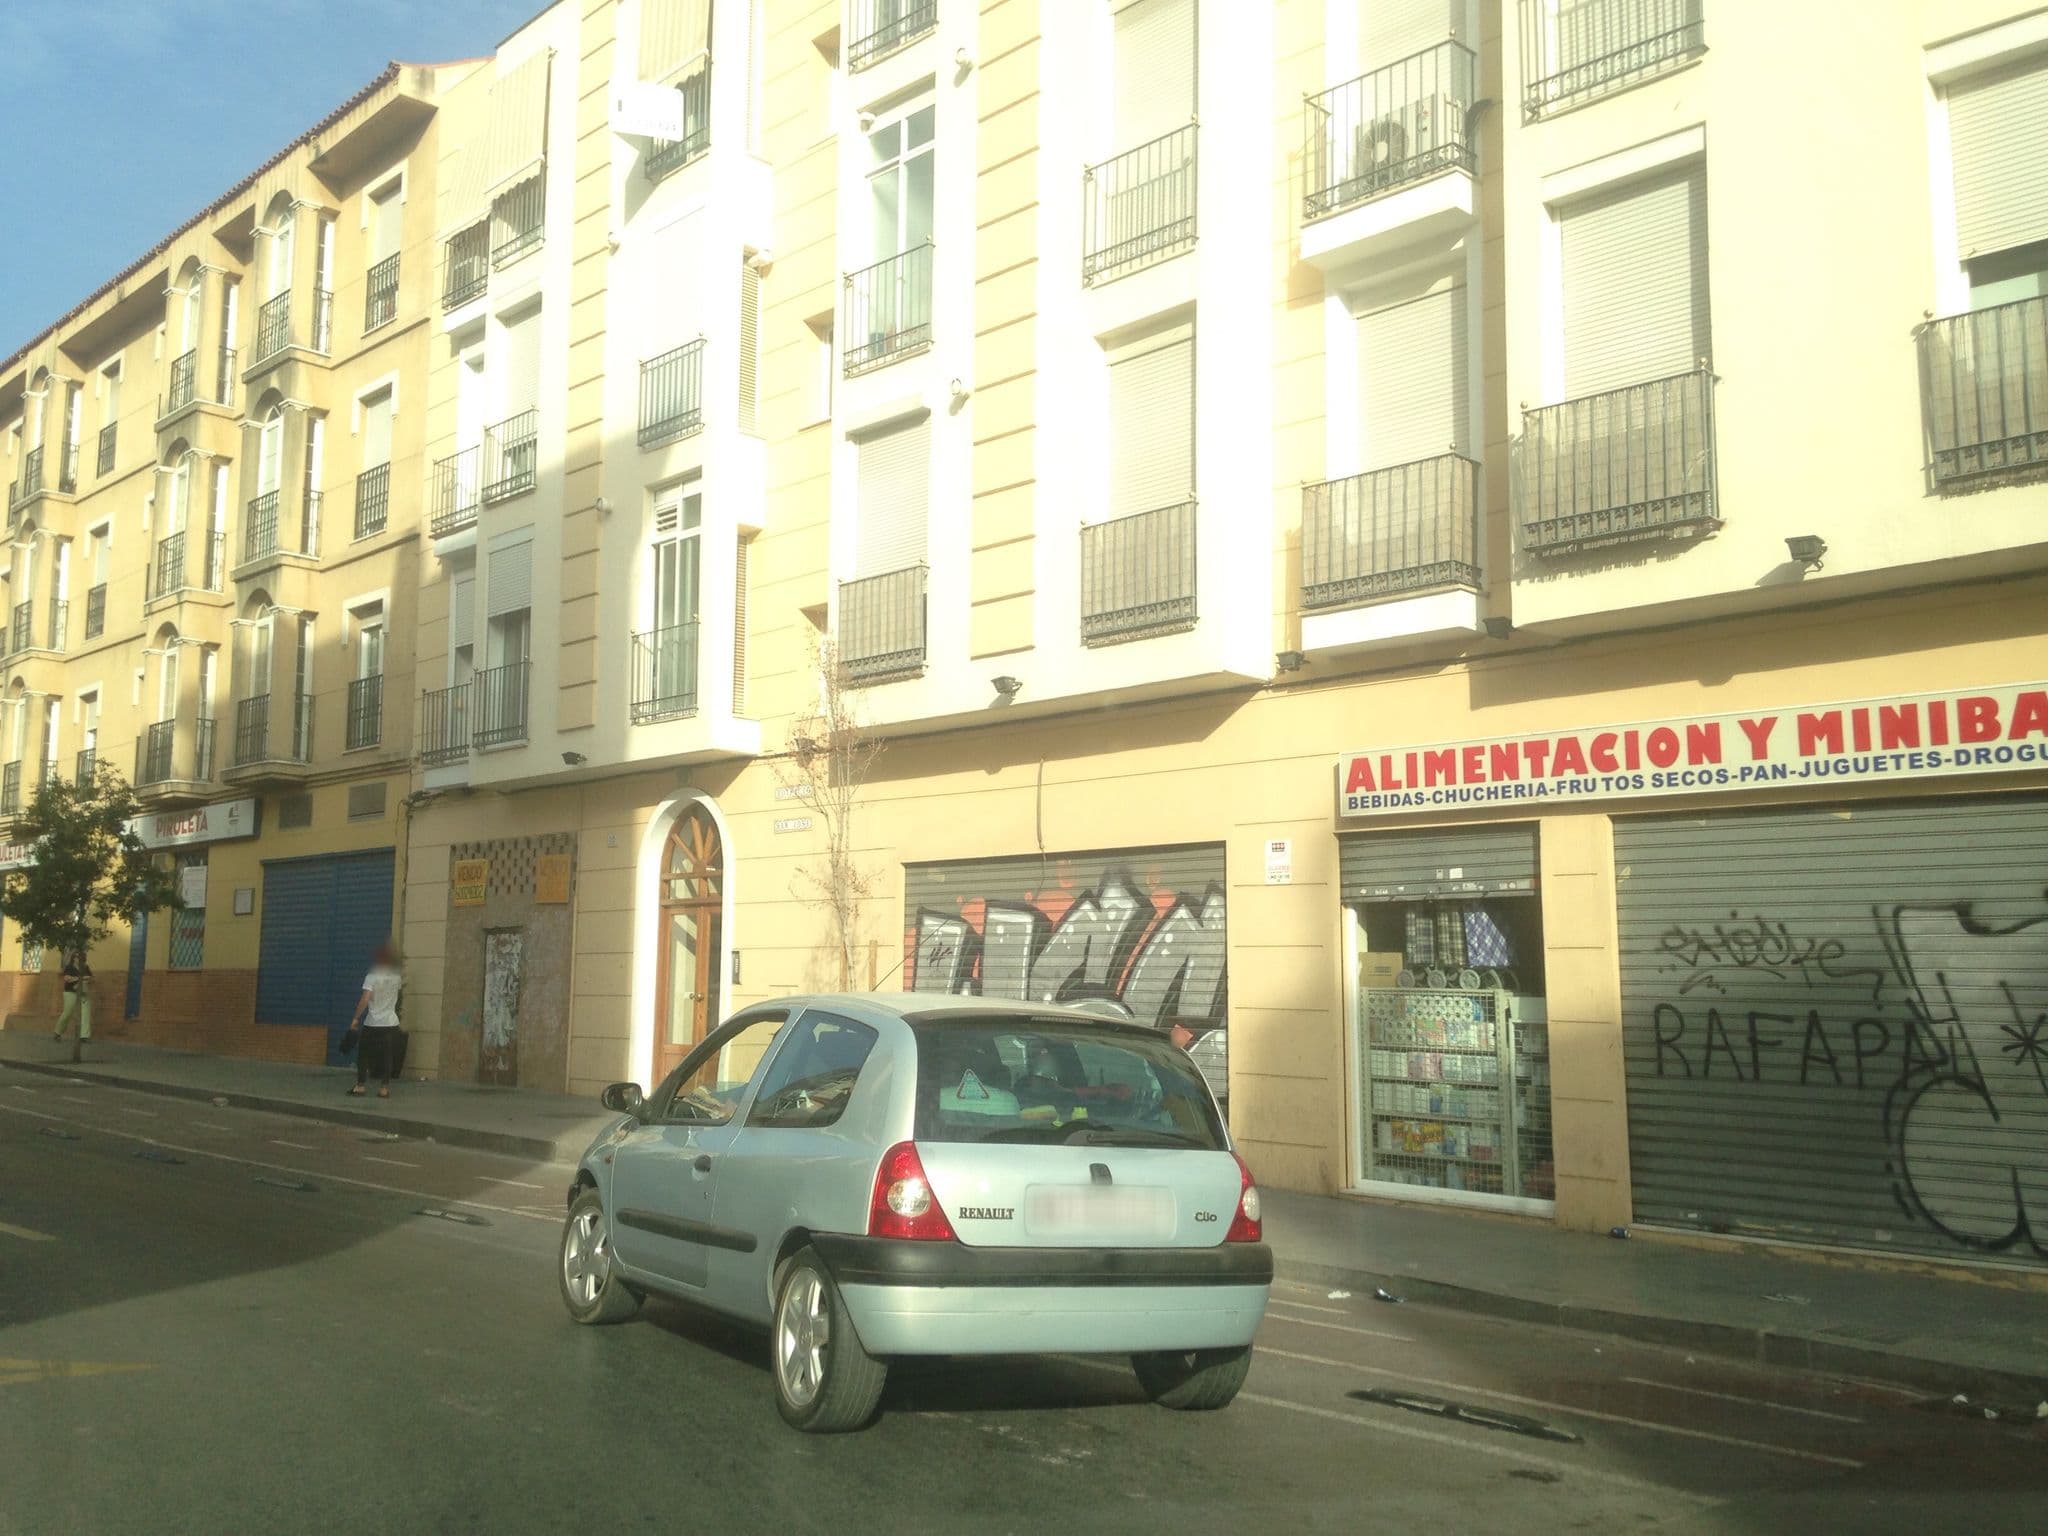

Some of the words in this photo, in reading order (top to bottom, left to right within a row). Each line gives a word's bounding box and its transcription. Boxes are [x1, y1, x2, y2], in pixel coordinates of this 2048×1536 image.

[1345, 722, 1722, 794] ALIMENTACION
[1737, 716, 1779, 761] Y
[1796, 690, 2048, 757] MINIBA
[959, 1206, 1015, 1220] RENAULT
[1195, 1211, 1217, 1222] Clio
